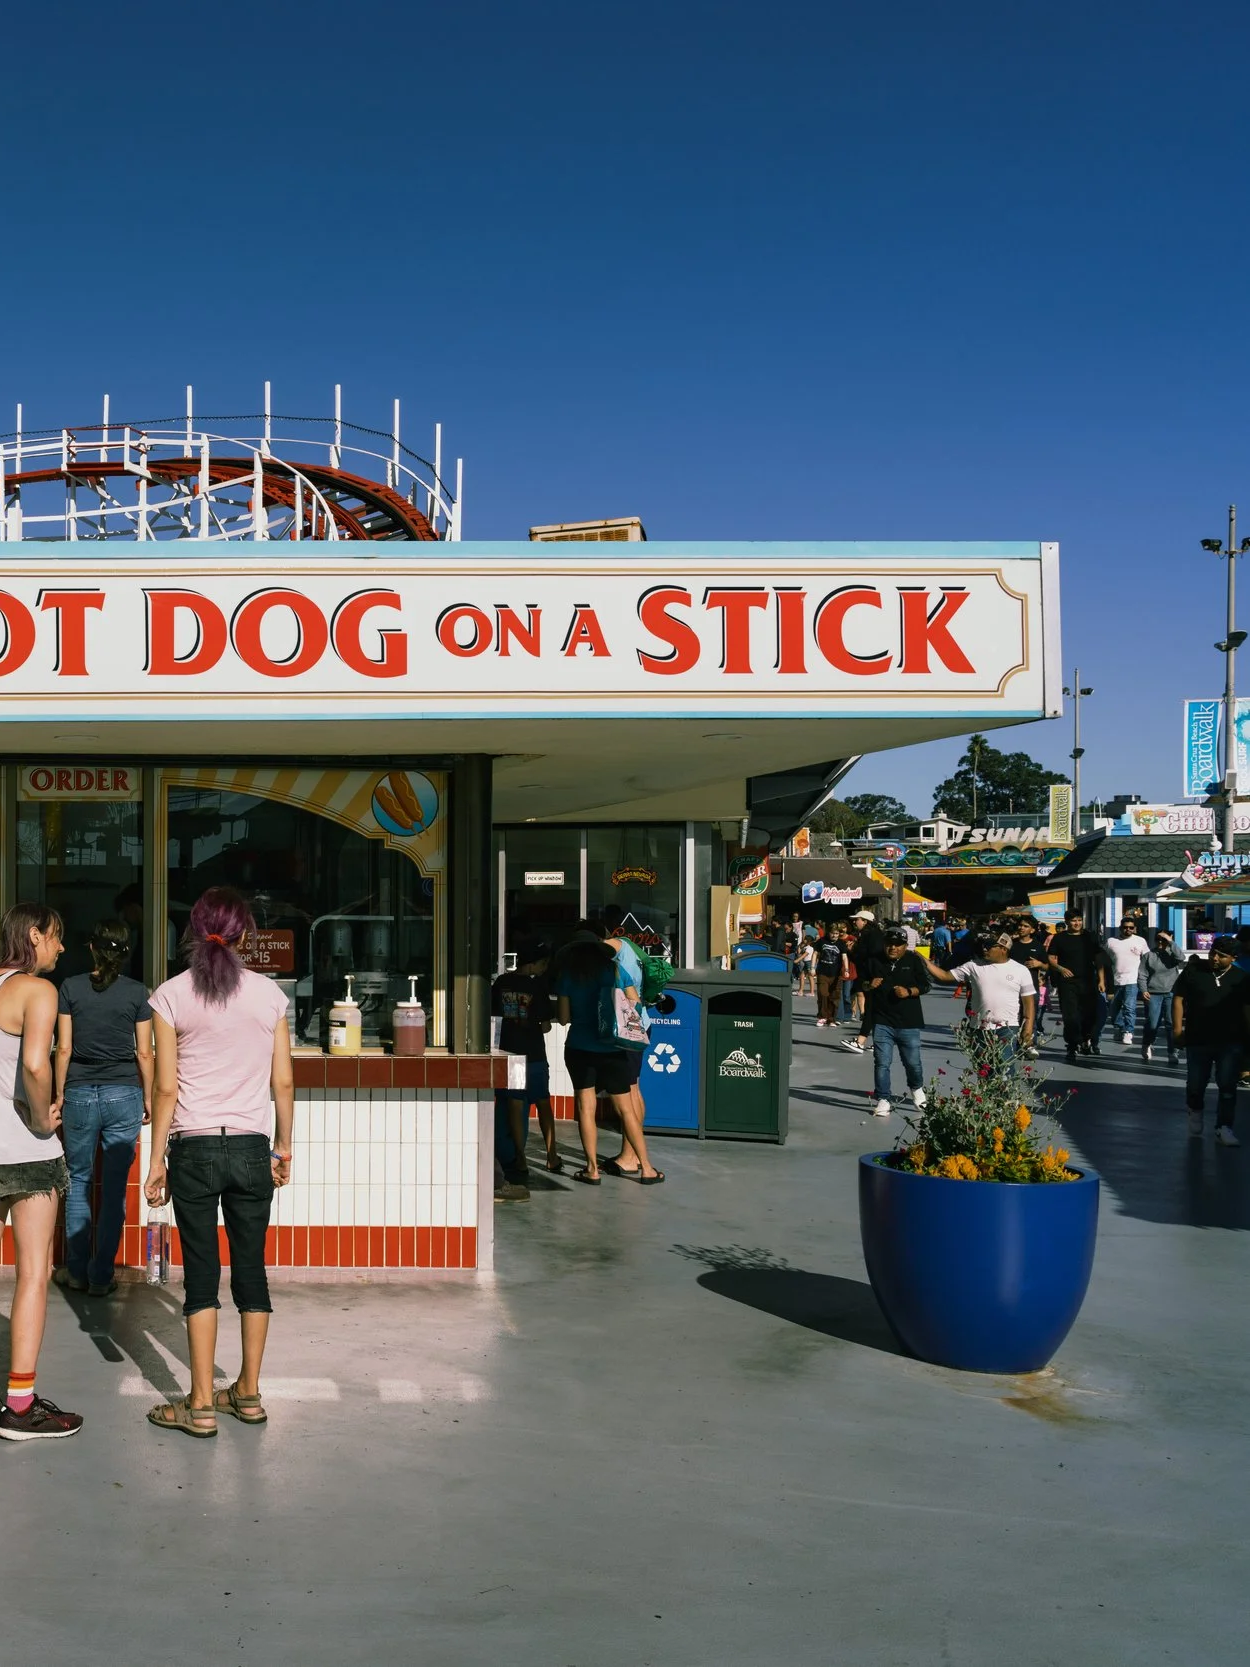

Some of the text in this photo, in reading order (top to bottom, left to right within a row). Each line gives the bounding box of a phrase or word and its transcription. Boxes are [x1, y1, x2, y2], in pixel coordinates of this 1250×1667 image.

[141, 586, 408, 678] DOG
[435, 602, 543, 658] ON
[560, 603, 612, 658] A
[636, 584, 977, 676] STICK
[1191, 703, 1215, 793] Boardwalk
[29, 767, 130, 791] ORDER
[1054, 787, 1068, 841] Boardwalk
[954, 826, 1051, 850] TSUNAM
[1197, 850, 1250, 873] dipp
[731, 864, 767, 887] BEER
[254, 950, 270, 963] $15
[267, 941, 290, 950] STICK
[718, 1065, 767, 1078] Boardwalk
